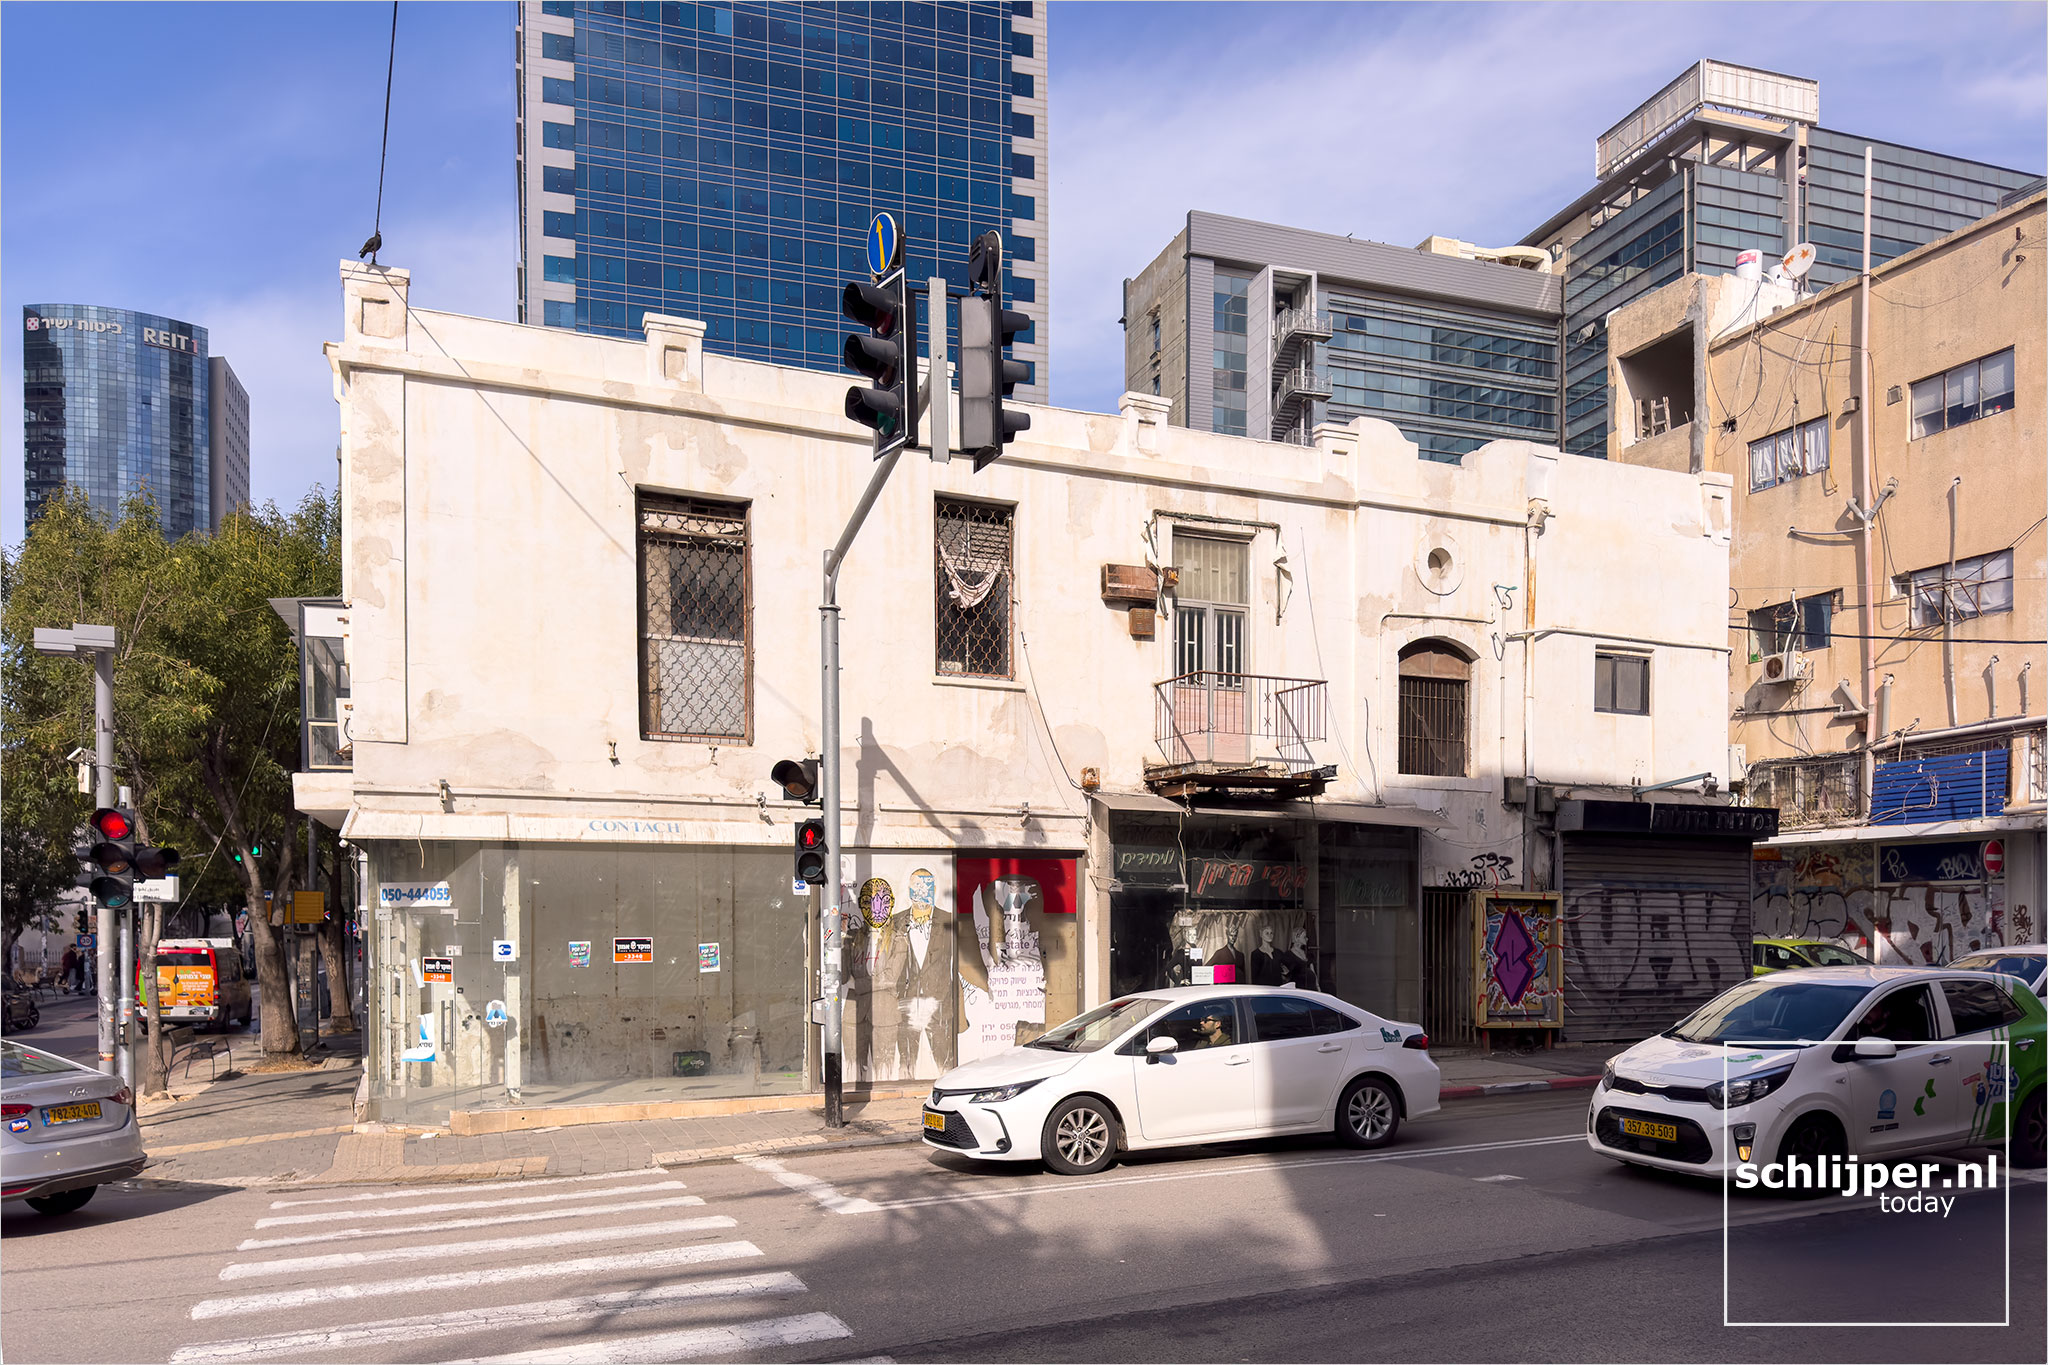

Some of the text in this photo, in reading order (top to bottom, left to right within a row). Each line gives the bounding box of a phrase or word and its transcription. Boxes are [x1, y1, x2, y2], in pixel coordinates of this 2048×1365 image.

[41, 317, 123, 335] ביטוח ישיר
[143, 326, 189, 350] REIT
[589, 820, 681, 833] CONTACH
[1197, 862, 1254, 895] הריון
